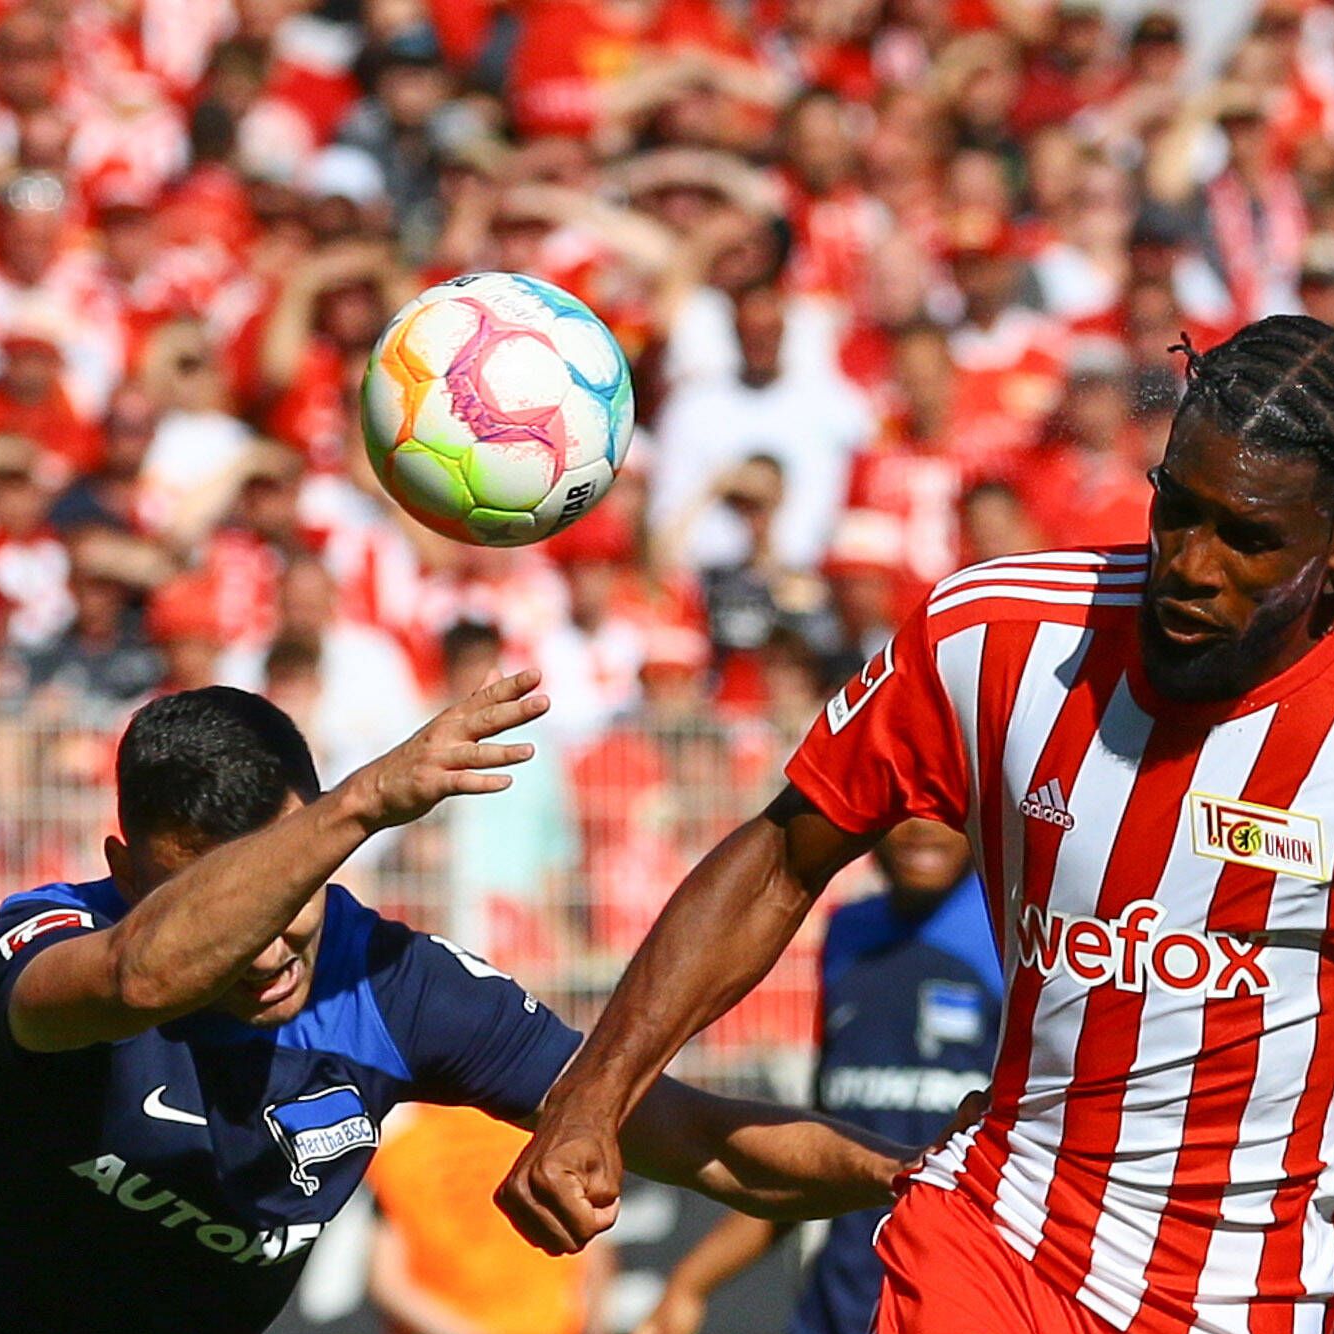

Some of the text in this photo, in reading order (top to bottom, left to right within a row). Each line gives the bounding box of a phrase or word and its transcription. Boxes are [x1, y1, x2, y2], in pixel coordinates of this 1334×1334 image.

[1020, 801, 1074, 829] adidas
[1264, 832, 1313, 865] UNION
[1016, 903, 1275, 996] wefox
[294, 1117, 372, 1158] Hertha BSC
